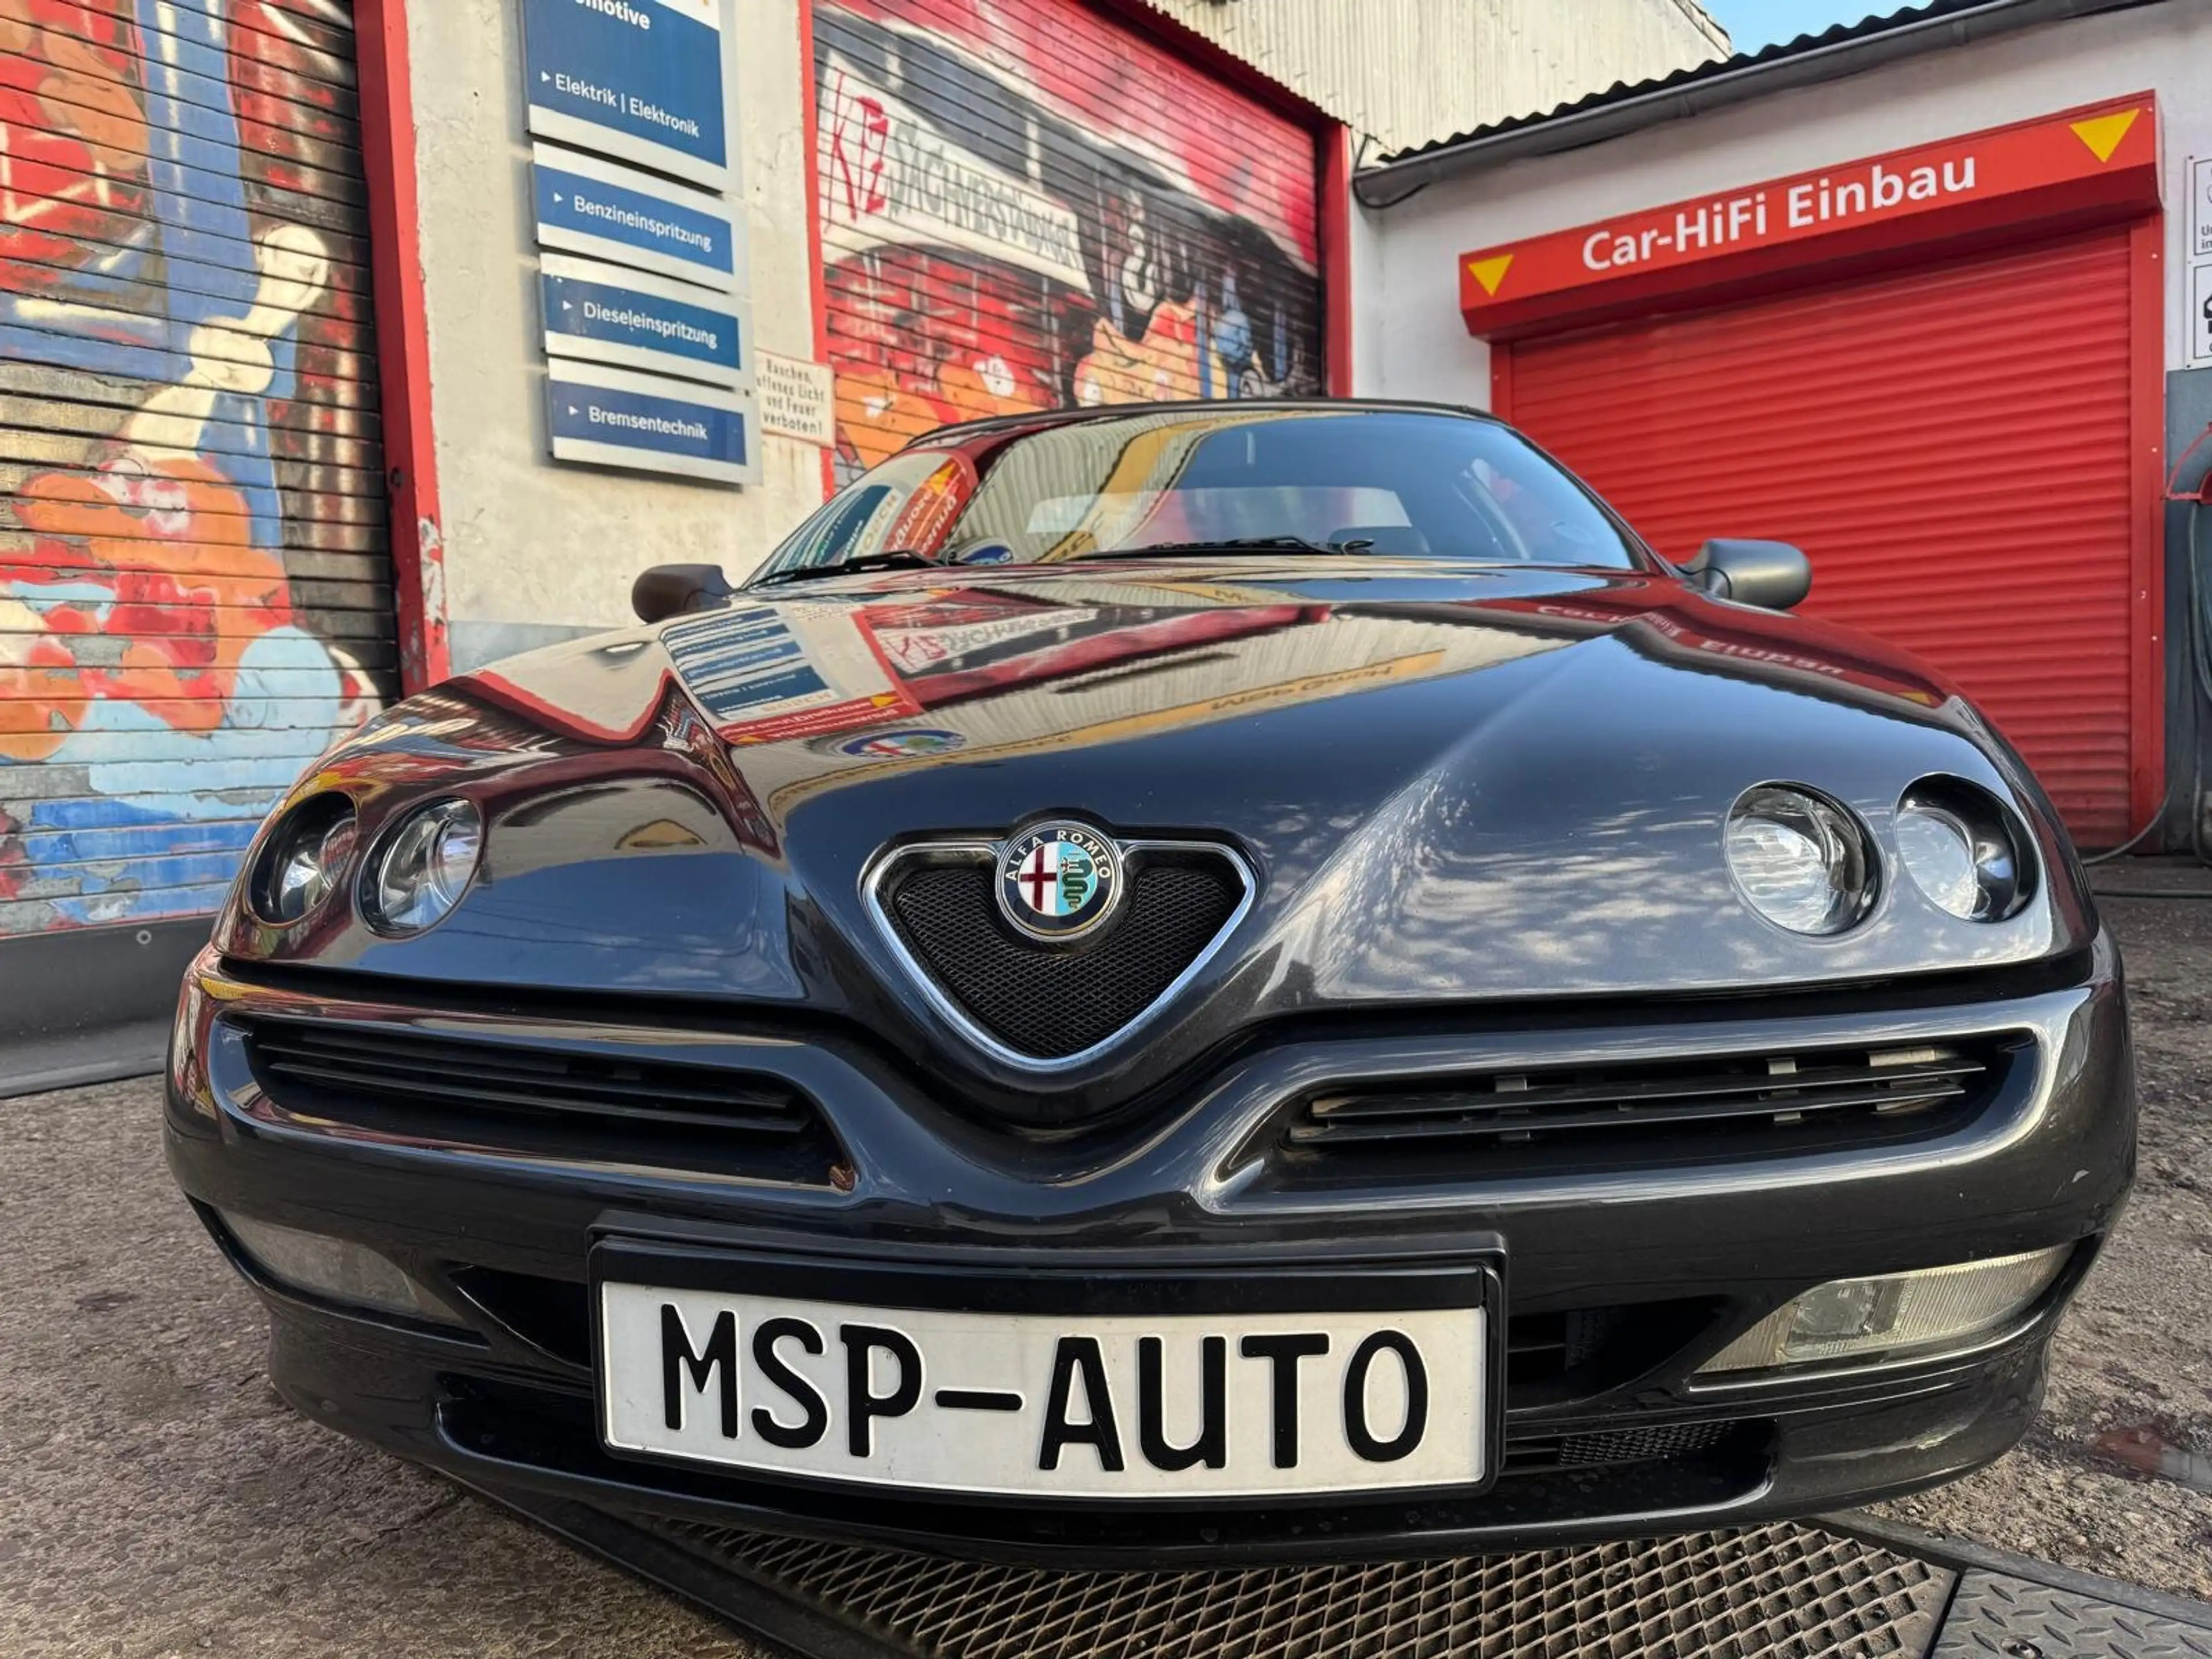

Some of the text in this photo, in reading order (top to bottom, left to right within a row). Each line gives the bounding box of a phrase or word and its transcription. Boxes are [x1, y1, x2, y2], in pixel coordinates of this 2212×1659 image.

[556, 74, 616, 107] Elektrik
[630, 97, 700, 138] Elektronik
[574, 195, 712, 252] Benzineinspritzung
[1582, 157, 1976, 270] Car-HiFi Einbau
[584, 301, 718, 349] Dieseleinspritzung
[589, 406, 707, 440] Bremsentechnik
[1005, 830, 1111, 881] ALFA ROMEO
[661, 1303, 1429, 1472] MSP-AUTO
